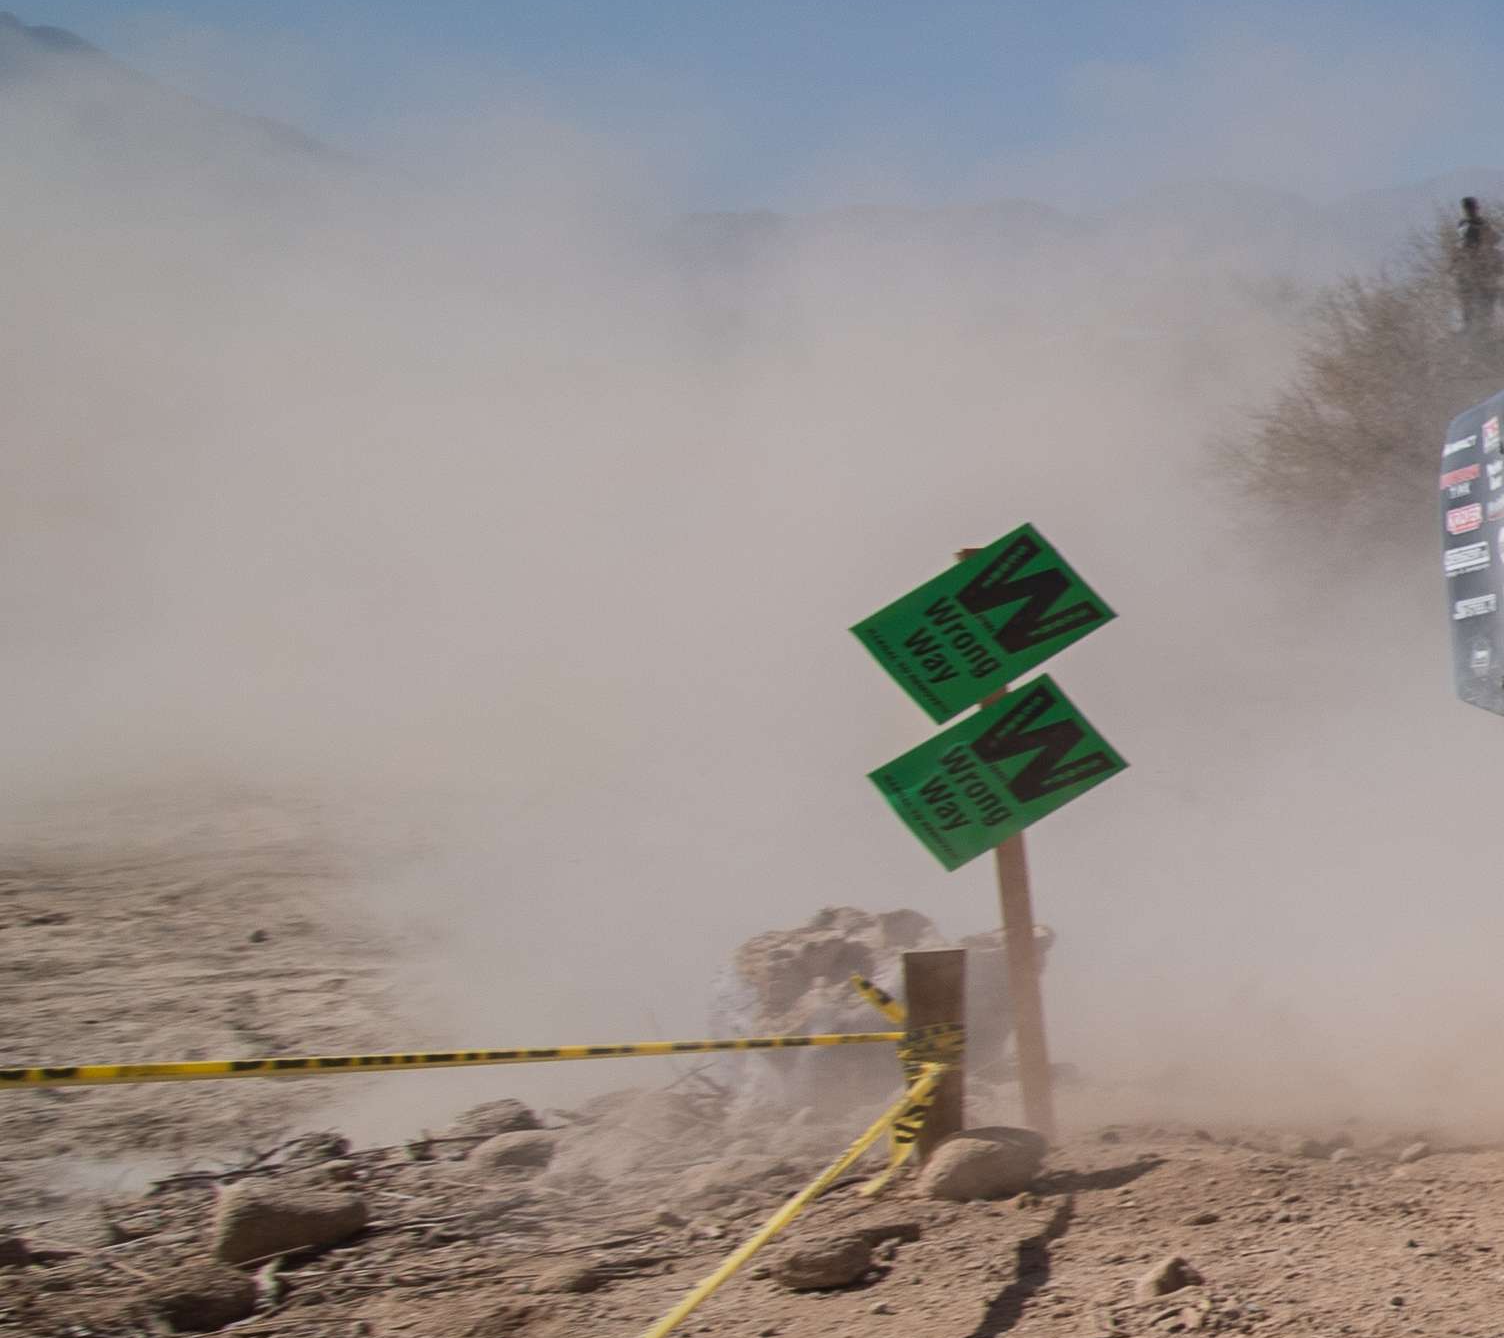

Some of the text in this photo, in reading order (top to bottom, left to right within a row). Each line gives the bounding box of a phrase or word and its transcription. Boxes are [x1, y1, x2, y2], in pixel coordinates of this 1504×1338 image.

[902, 626, 960, 684] Way
[923, 596, 1001, 679] Wrong
[919, 774, 972, 832] Way
[939, 743, 1012, 828] Wrong
